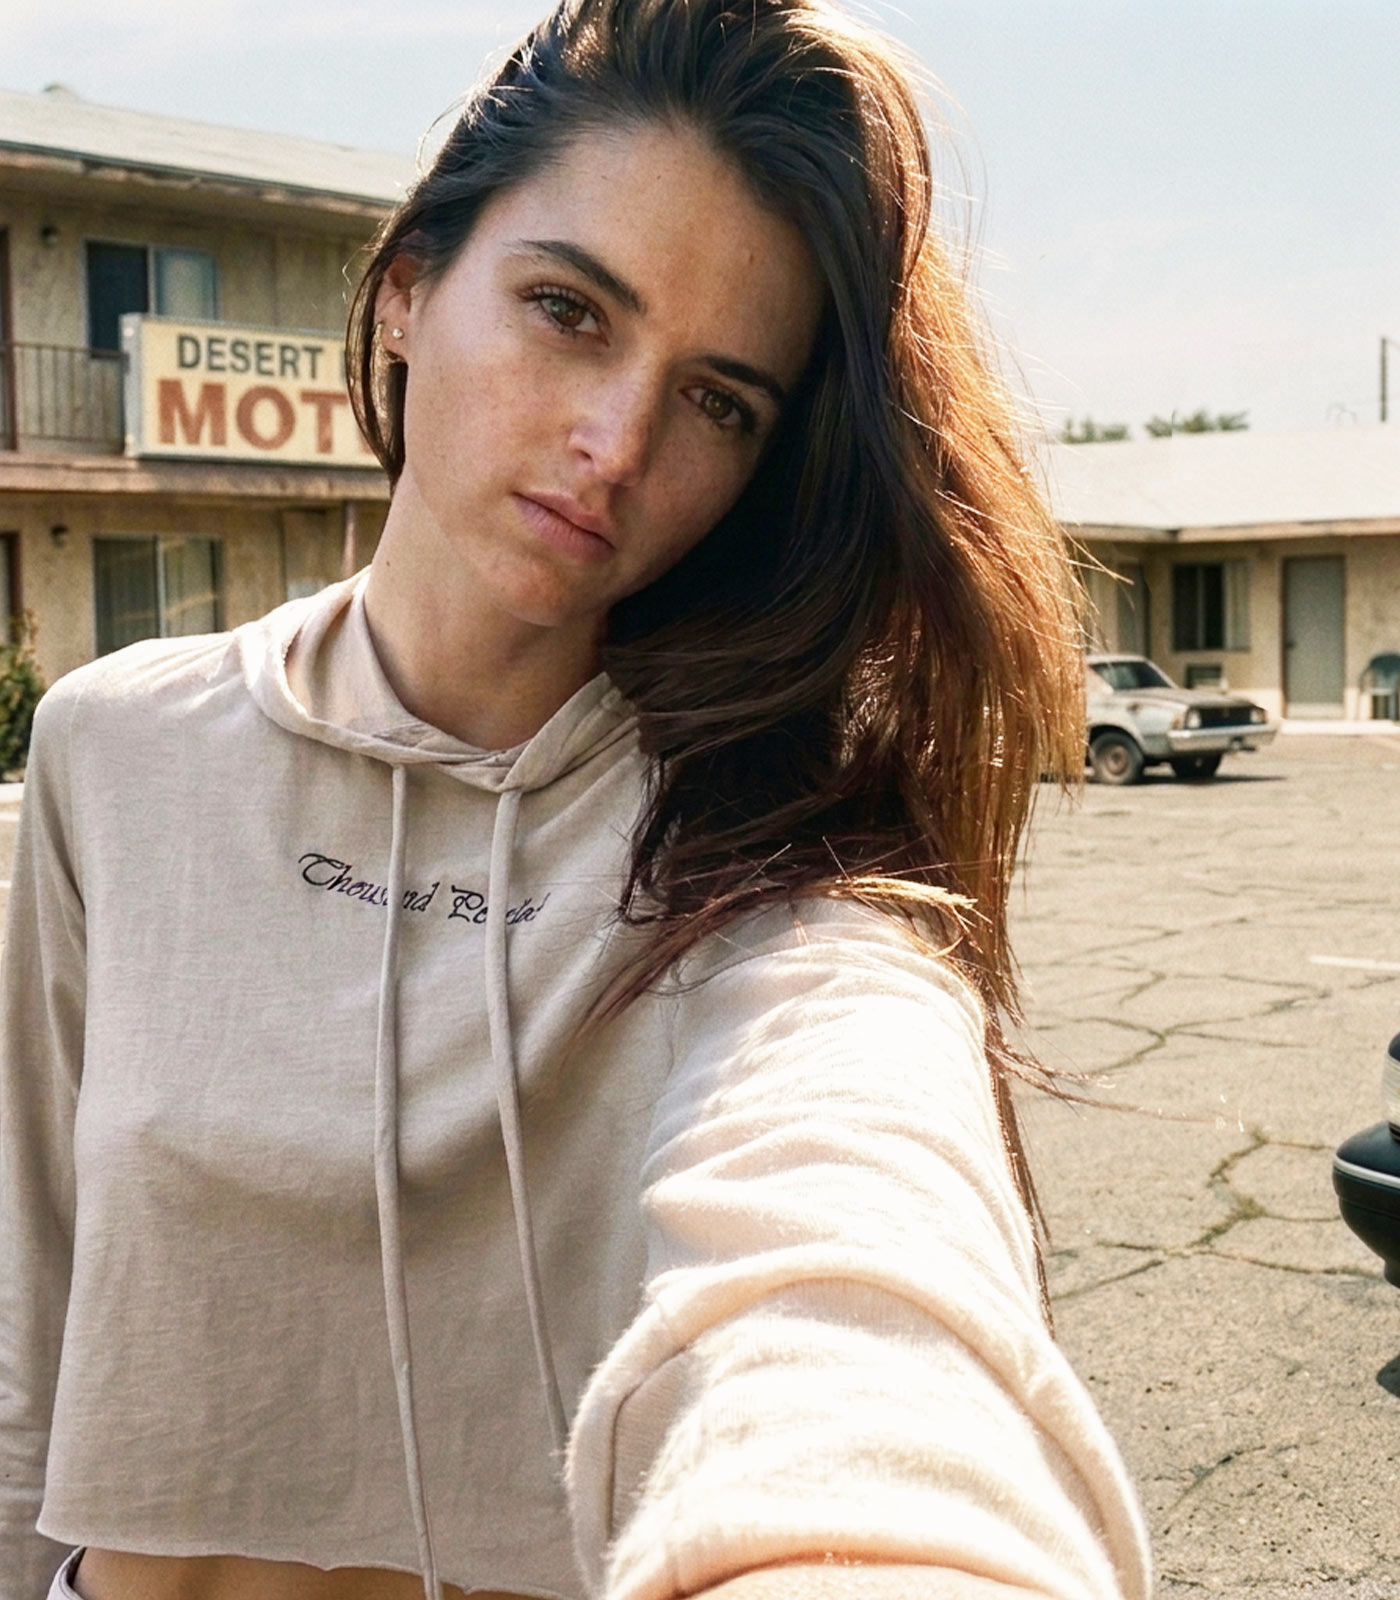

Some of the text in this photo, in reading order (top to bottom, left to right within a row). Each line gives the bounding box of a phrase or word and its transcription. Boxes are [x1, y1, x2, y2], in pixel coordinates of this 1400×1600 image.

[177, 335, 323, 379] DESERT
[158, 379, 375, 454] MOT
[298, 853, 440, 912] Thousnd
